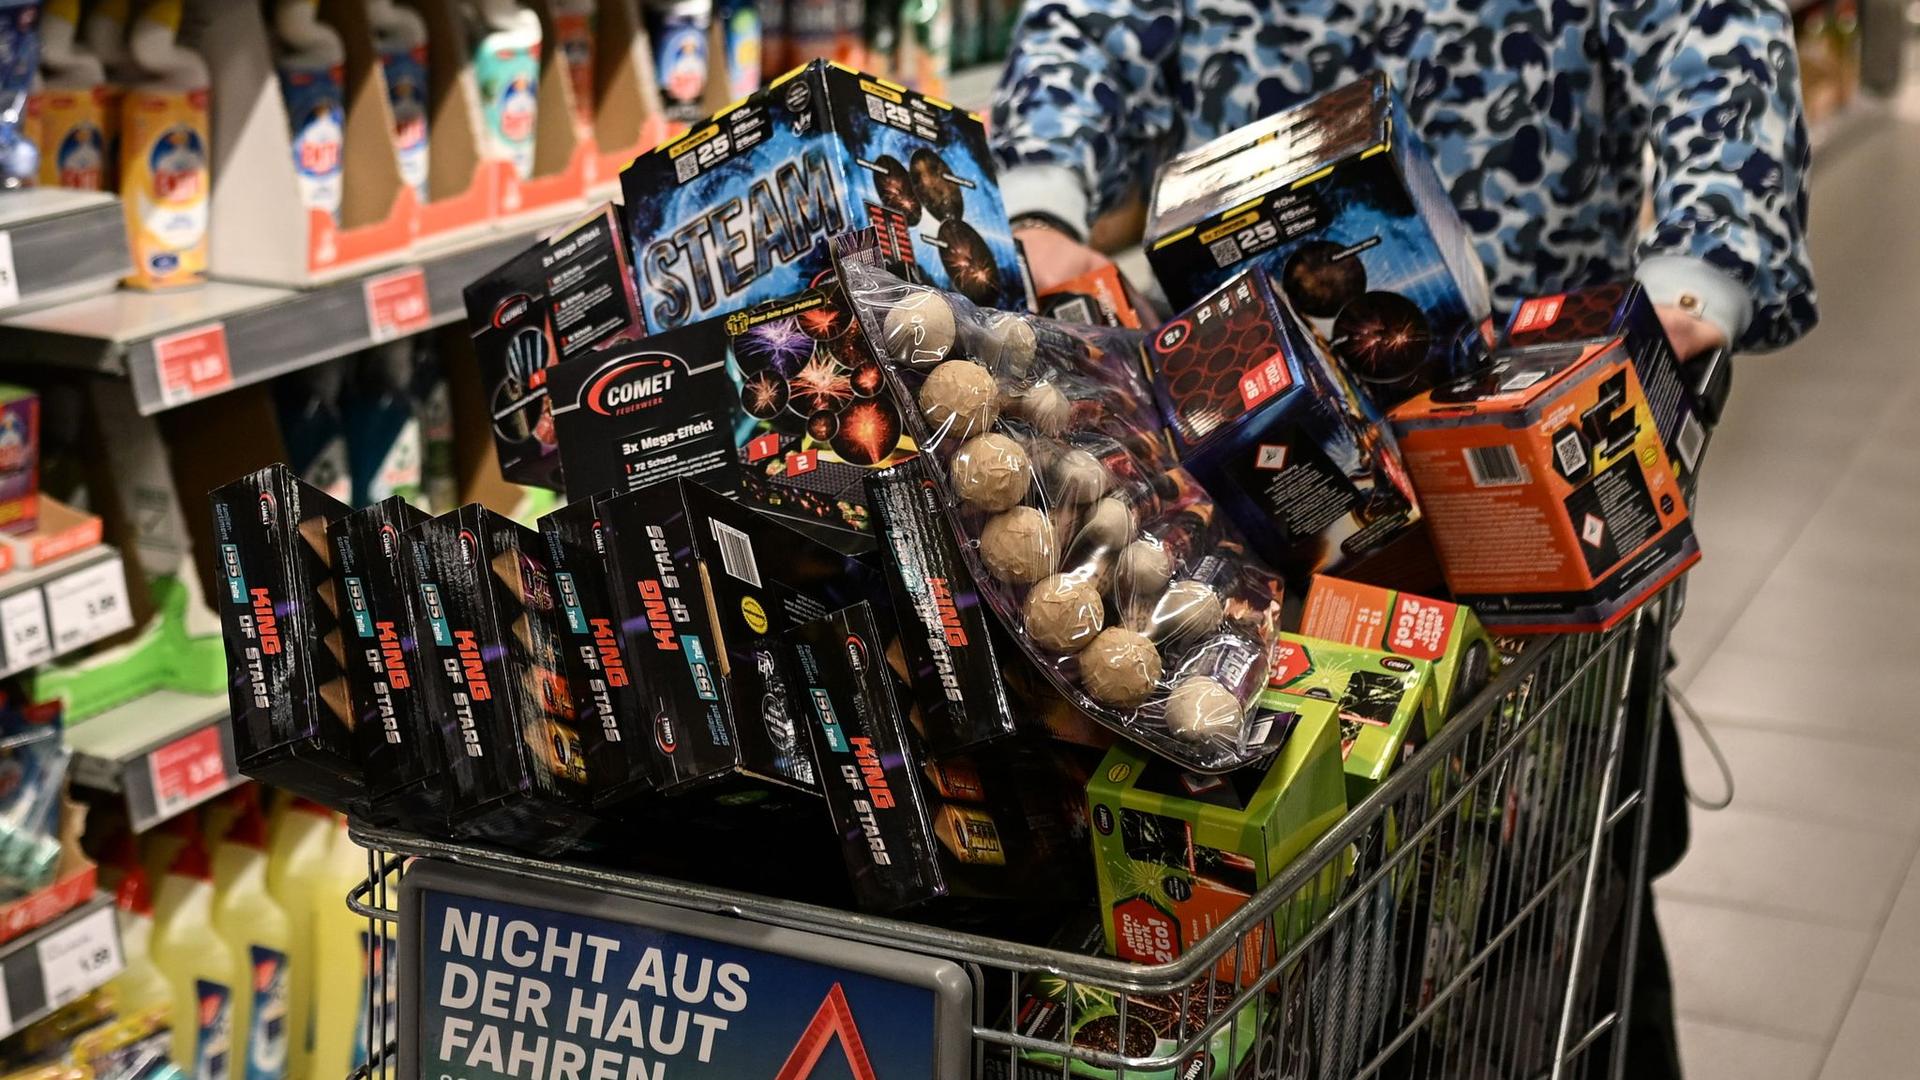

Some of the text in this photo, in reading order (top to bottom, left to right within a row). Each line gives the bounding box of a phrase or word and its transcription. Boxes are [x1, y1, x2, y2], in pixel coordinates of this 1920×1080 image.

[884, 102, 911, 126] 25
[697, 133, 730, 165] 25
[643, 149, 847, 332] STEAM
[1237, 220, 1277, 250] 25
[607, 370, 675, 407] COMET
[615, 397, 664, 416] FEUERWERK
[622, 419, 715, 456] 3x Mega-Effekt
[757, 440, 769, 456] 1
[795, 455, 808, 471] 2
[260, 500, 270, 526] COMET
[382, 532, 392, 559] COMET
[460, 538, 472, 565] COMET
[594, 528, 605, 554] COMET
[224, 545, 242, 578] 195
[645, 525, 691, 623] OF STARS
[347, 579, 366, 612] 195
[423, 585, 443, 620] 195
[559, 574, 579, 608] 195
[250, 587, 282, 655] KING
[637, 579, 680, 651] KING
[925, 577, 968, 647] KING
[239, 614, 270, 709] OF STARS
[376, 621, 410, 690] KING
[454, 630, 491, 701] KING
[590, 618, 629, 688] KING
[848, 644, 861, 672] COMET
[927, 637, 963, 702] STARS
[1386, 659, 1412, 670] COMET
[365, 648, 401, 744] OF STARS
[580, 645, 622, 743] OF STARS
[690, 662, 716, 699] 195
[443, 658, 483, 758] OF STARS
[812, 690, 836, 725] 195
[661, 717, 674, 744] COMET
[850, 736, 896, 809] KING
[840, 764, 891, 867] OF STARS
[1122, 913, 1135, 948] micro
[1134, 919, 1146, 957] Feuer-
[1141, 925, 1155, 955] werk
[439, 906, 752, 1013] NICHT AUS
[439, 963, 729, 1064] DER HAUT
